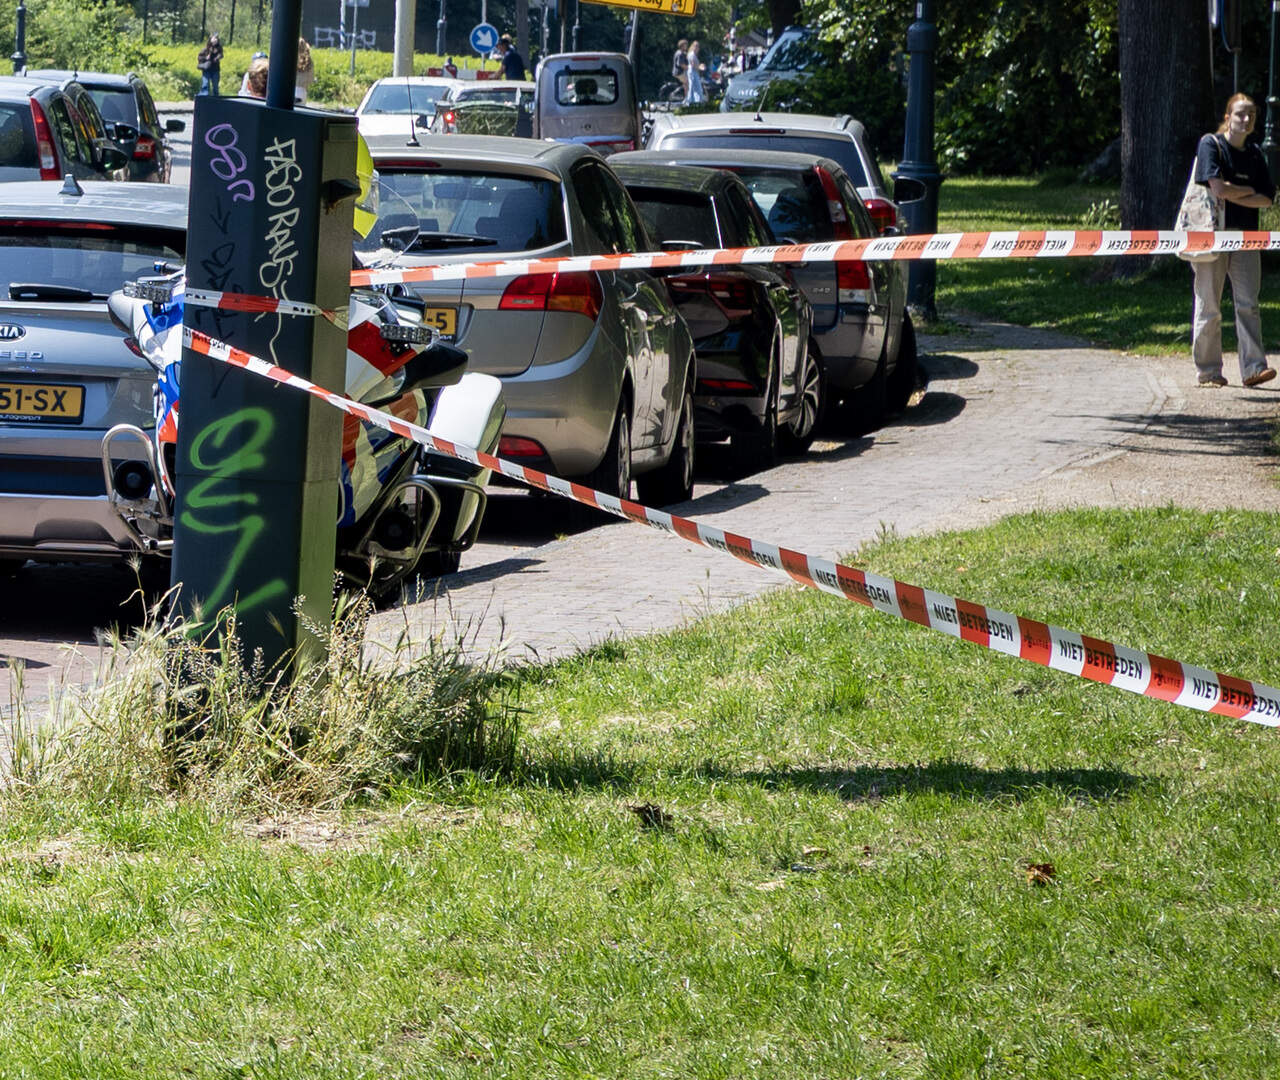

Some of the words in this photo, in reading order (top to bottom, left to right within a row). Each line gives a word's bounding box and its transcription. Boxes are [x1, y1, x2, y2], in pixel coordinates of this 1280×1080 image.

[815, 568, 839, 589] NIET
[933, 602, 958, 625] NIET
[958, 611, 1014, 642] BETREDEN
[1058, 639, 1084, 662] NIET
[1086, 648, 1143, 680] BETREDEN
[1192, 677, 1219, 701] NIET
